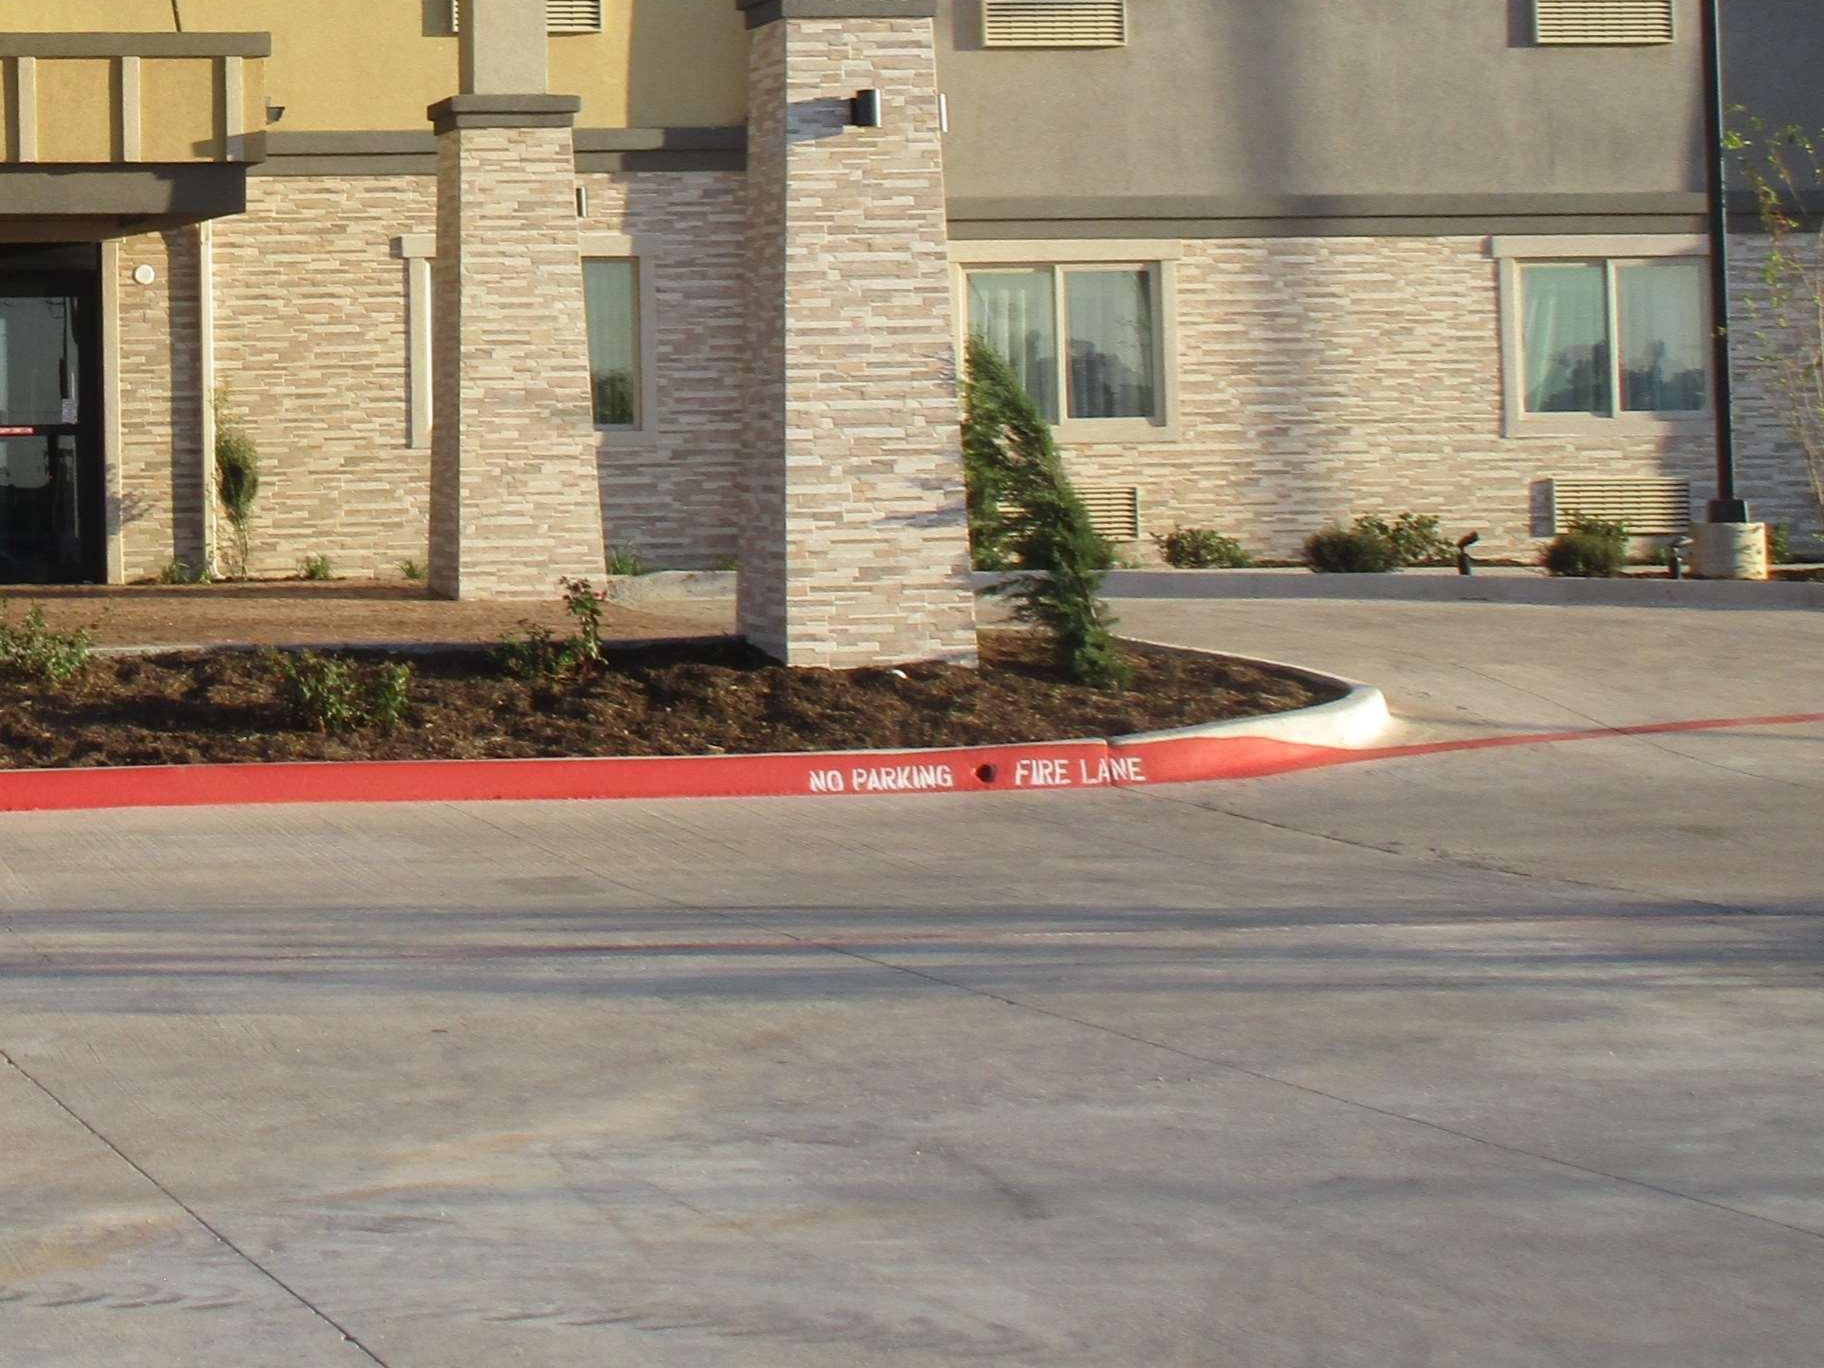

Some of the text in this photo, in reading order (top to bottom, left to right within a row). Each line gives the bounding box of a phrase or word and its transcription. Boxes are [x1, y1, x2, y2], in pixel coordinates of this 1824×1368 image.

[808, 757, 1147, 793] NO PARKING FIRE LANE
